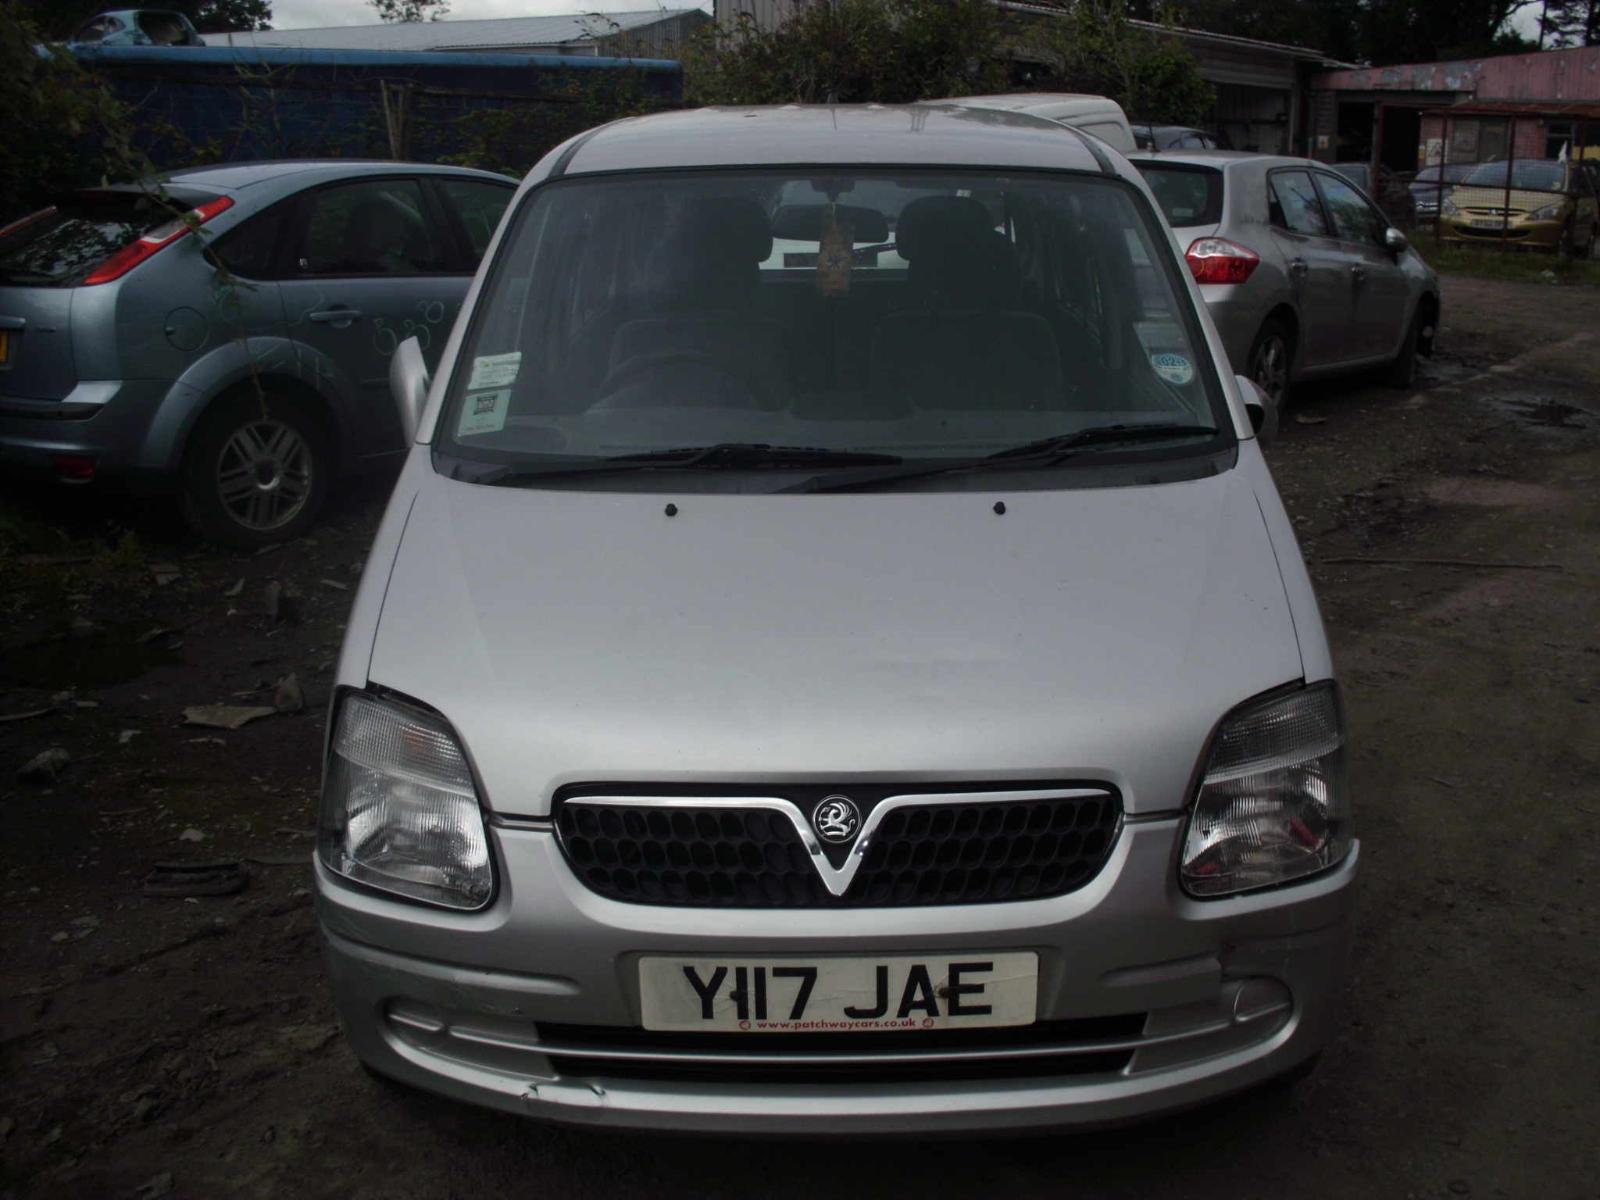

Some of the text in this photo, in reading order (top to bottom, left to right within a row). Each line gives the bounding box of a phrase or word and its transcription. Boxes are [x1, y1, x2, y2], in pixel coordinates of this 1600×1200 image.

[683, 962, 993, 1020] Y117 JAE
[757, 1018, 916, 1030] www.patchwaycars.co.uk
